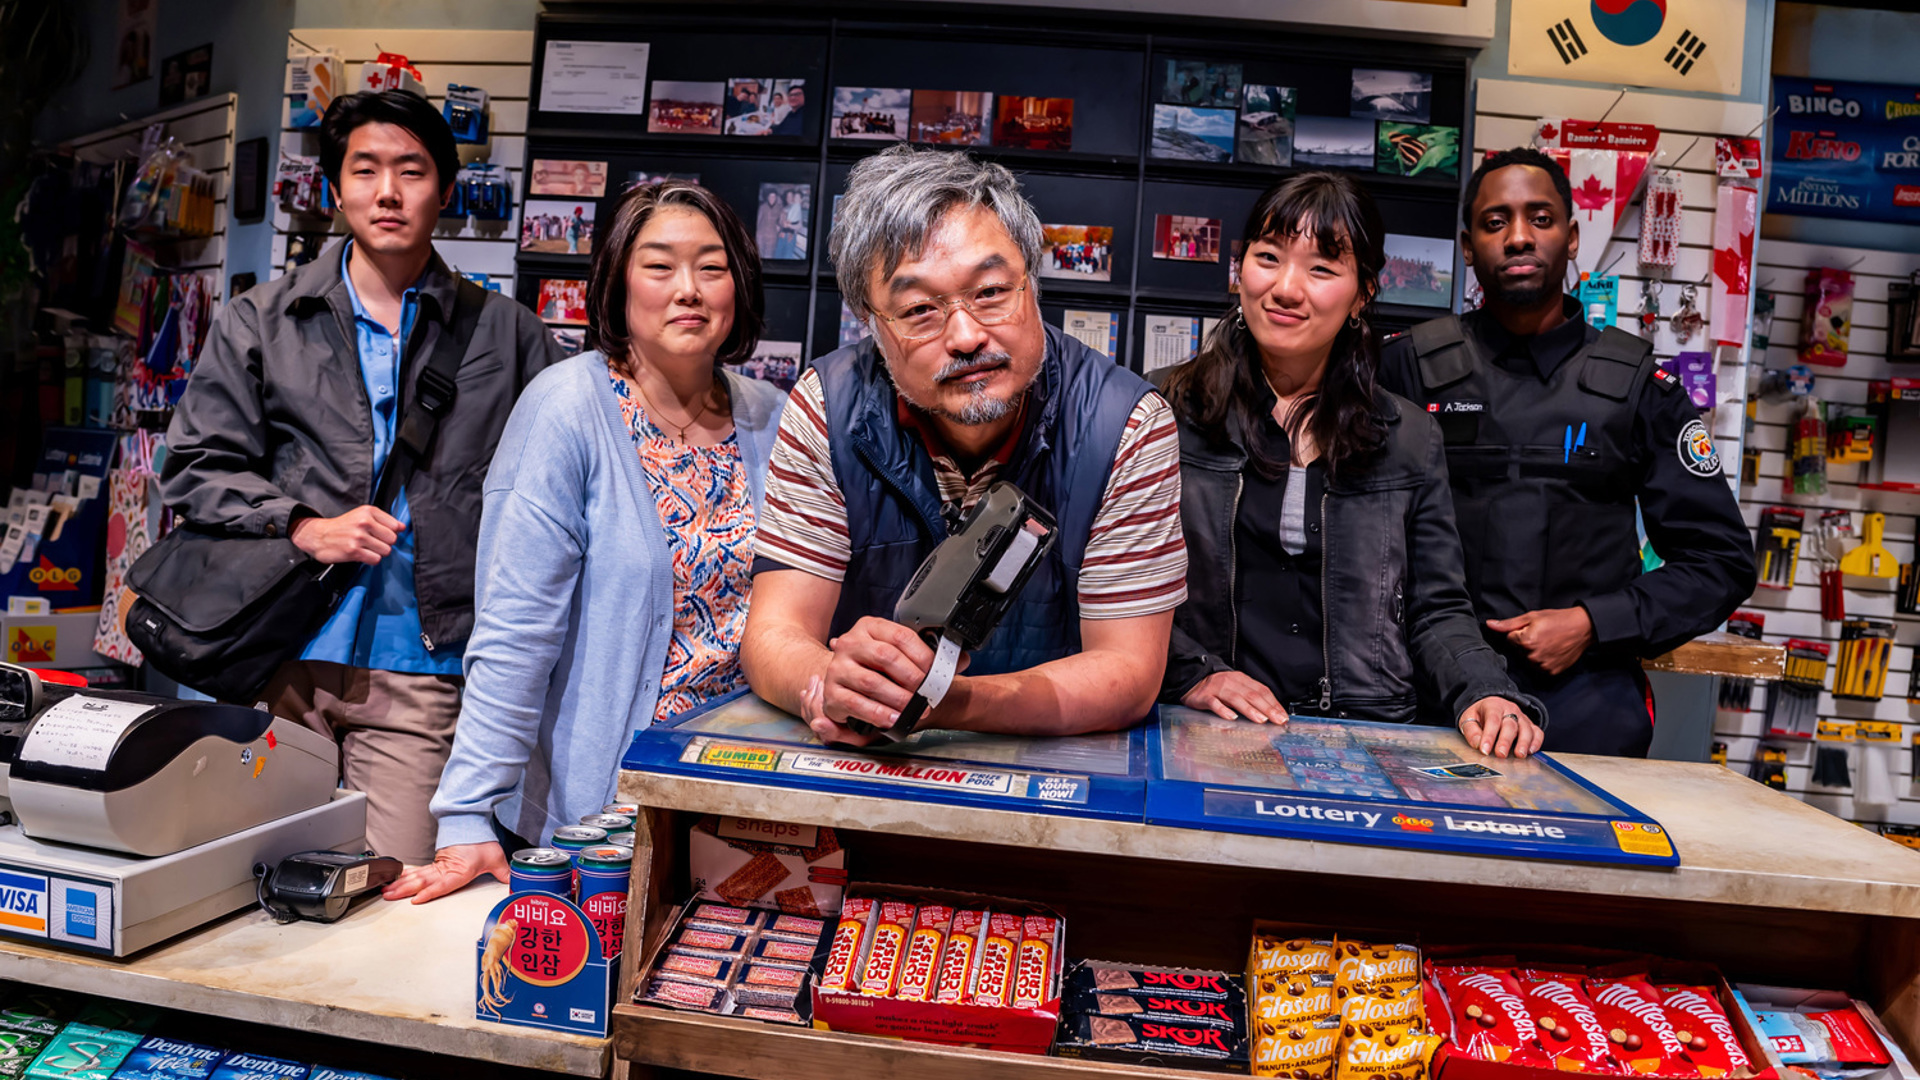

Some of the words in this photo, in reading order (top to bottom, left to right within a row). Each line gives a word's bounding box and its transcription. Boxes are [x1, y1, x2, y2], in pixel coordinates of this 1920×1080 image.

[1788, 94, 1860, 118] BINGO
[1567, 132, 1599, 143] Banner
[1608, 134, 1647, 145] Bannière
[1785, 130, 1861, 161] KENO
[279, 162, 313, 174] Energizer
[1883, 152, 1919, 168] FOR
[1777, 186, 1860, 209] MILLIONS
[1798, 180, 1840, 193] INSTANT
[1586, 280, 1614, 289] Advil
[1444, 402, 1454, 412] A
[32, 568, 80, 583] OLG
[712, 749, 769, 762] JUMBO
[833, 760, 875, 774] $100
[875, 763, 967, 784] MILLION
[966, 778, 995, 787] POOL
[970, 772, 1004, 781] PRIZE
[1038, 781, 1078, 792] YOURS
[1039, 788, 1074, 799] NOW!
[736, 817, 800, 838] snaps
[1255, 800, 1382, 828] Lottery
[1393, 816, 1433, 827] OLG
[1444, 816, 1566, 839] Loterie
[0, 887, 39, 914] VISA
[65, 903, 95, 916] AMERICAN
[513, 903, 567, 926] 비비요
[520, 926, 563, 953] 강한
[825, 926, 847, 977] COFFEE
[520, 952, 561, 977] 인삼
[833, 934, 853, 976] CRISP
[866, 929, 890, 980] COFFEE
[877, 939, 898, 981] CRISP
[903, 934, 926, 986] COFFEE
[913, 944, 933, 987] CRISP
[940, 940, 957, 991] COFFEE
[949, 949, 966, 991] CRISP
[978, 942, 999, 994] COFFEE
[989, 953, 1007, 997] CRISP
[1016, 946, 1034, 998] COFFEE
[1028, 955, 1043, 1000] CRISP
[1339, 956, 1417, 981] Glosette
[1143, 972, 1228, 993] SKOR
[1147, 997, 1234, 1022] SKOR
[1341, 996, 1418, 1022] Glosett
[1458, 973, 1538, 1041] Maltesers
[1596, 983, 1683, 1054] Maltesers
[1530, 981, 1610, 1062] Maltesers
[1664, 990, 1749, 1066] Maltesers
[143, 1037, 221, 1062] Dentyne
[1142, 1023, 1230, 1052] SKOR
[147, 1054, 191, 1072] ice
[1347, 1038, 1425, 1064] Glosett
[225, 1053, 306, 1077] Dentyne
[1257, 1062, 1291, 1071] PEANUTS
[1350, 1063, 1386, 1073] PEANUTS
